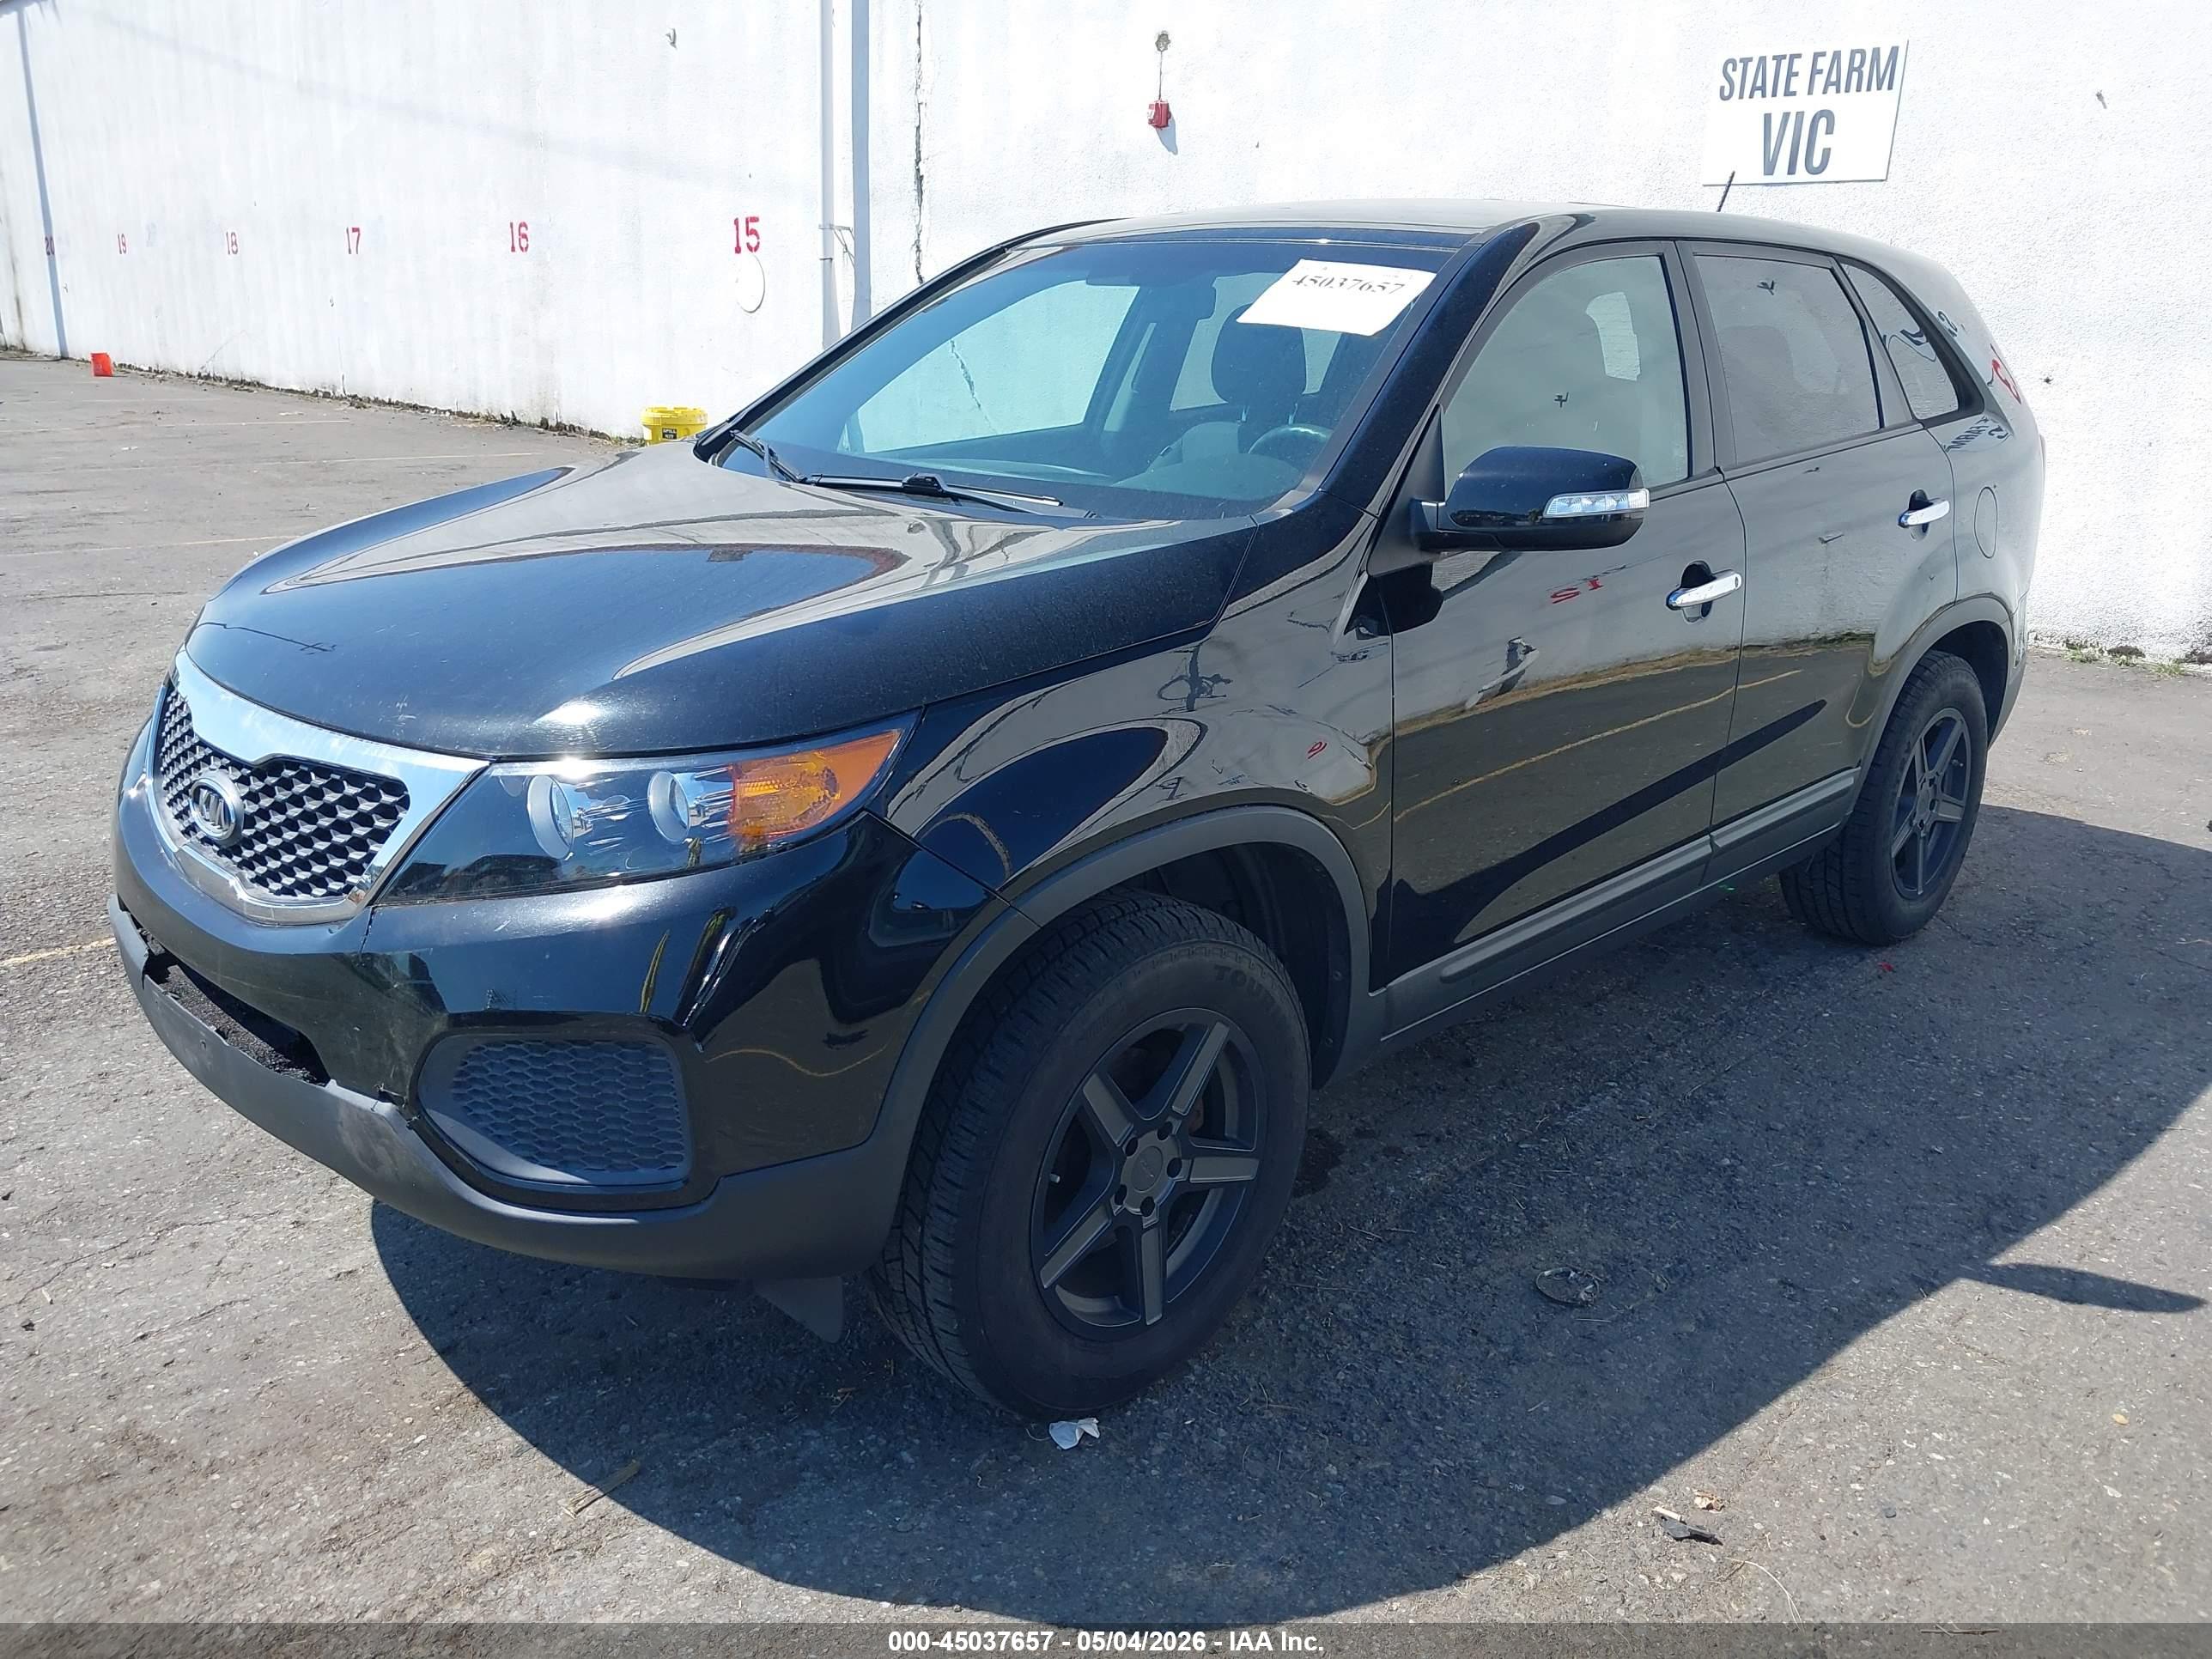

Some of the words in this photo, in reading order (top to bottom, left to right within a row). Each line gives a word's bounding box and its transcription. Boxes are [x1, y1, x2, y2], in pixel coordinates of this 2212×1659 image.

[1719, 52, 1802, 101] STATE
[1808, 46, 1900, 95] FARM
[1763, 108, 1836, 176] VIC
[44, 235, 56, 257] 20
[117, 233, 128, 255] 19
[225, 231, 239, 255] 18
[346, 226, 362, 255] 17
[509, 221, 530, 253] 16
[732, 215, 762, 255] 15
[1291, 273, 1407, 295] 45037657
